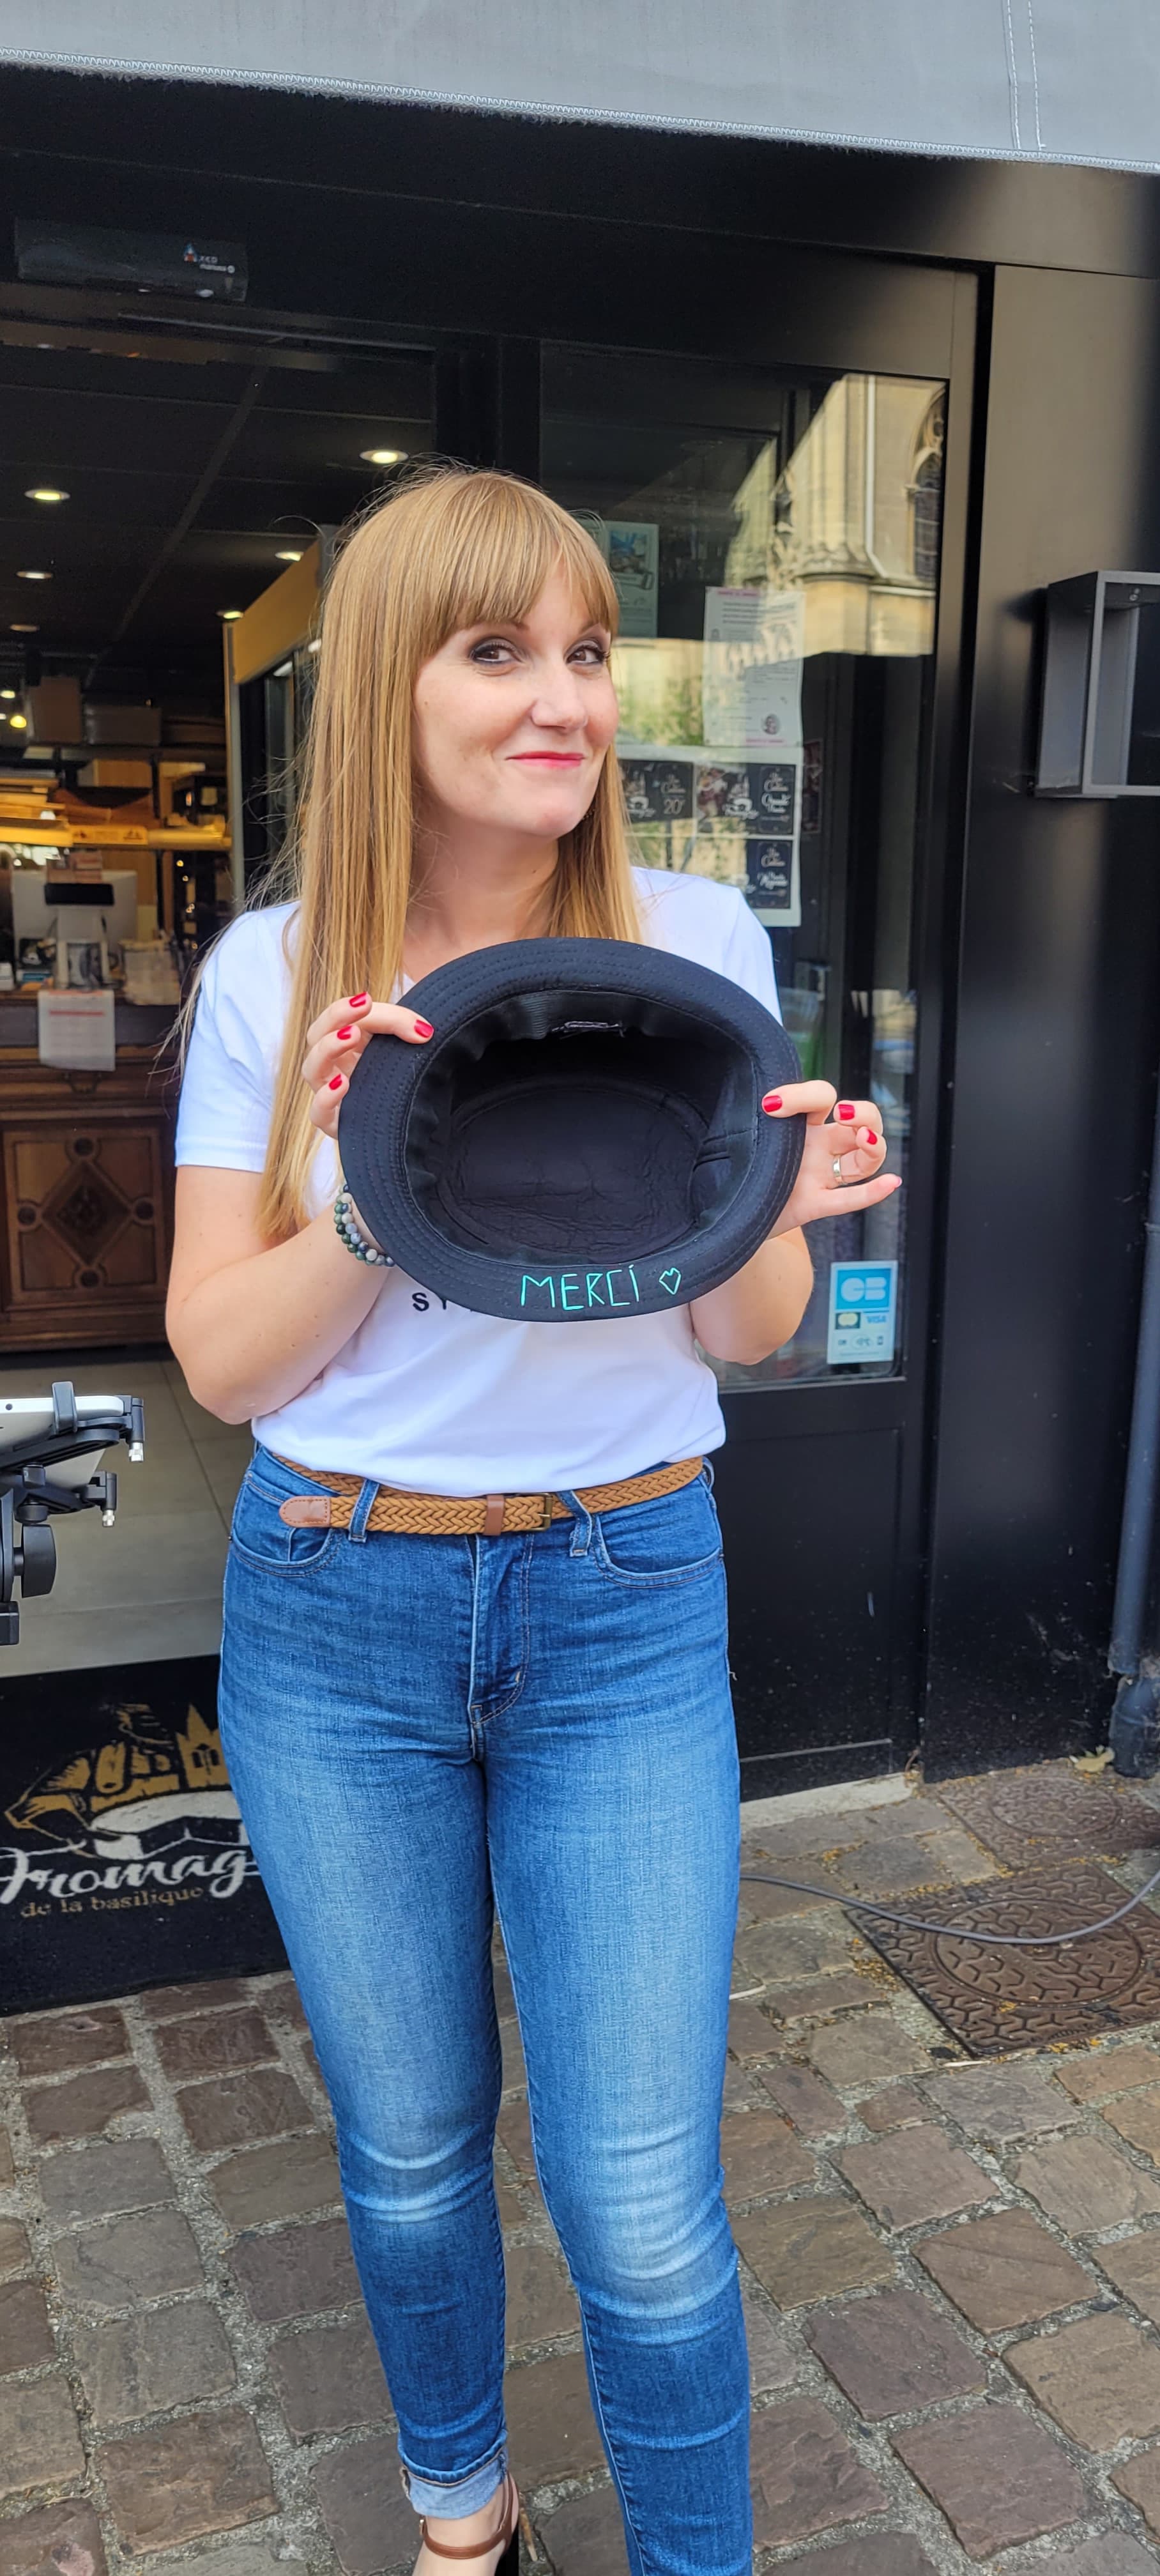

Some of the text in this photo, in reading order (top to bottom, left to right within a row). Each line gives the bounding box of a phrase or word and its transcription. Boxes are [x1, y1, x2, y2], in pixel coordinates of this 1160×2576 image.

[0, 1840, 261, 1905] Fromag
[20, 1887, 204, 1917] de la basilique
